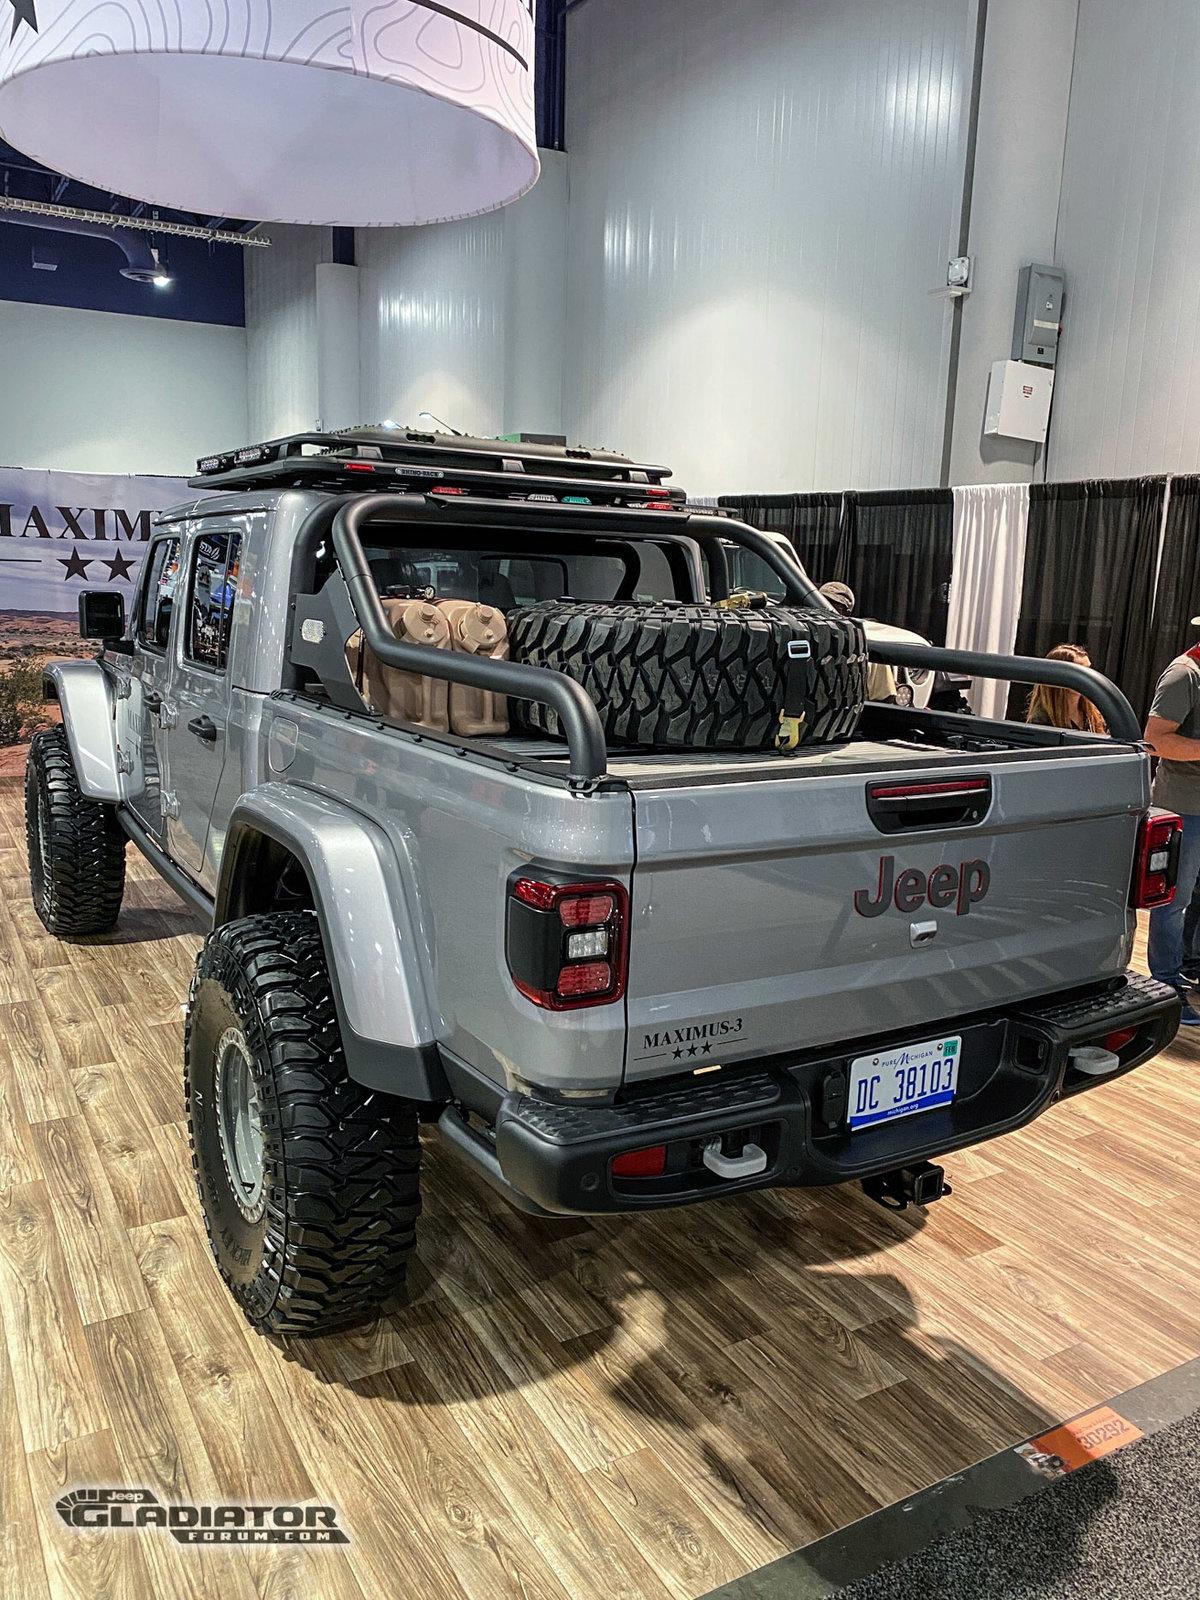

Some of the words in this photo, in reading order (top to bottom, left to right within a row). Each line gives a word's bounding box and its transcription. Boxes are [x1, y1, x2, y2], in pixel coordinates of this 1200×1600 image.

[0, 503, 163, 542] AXIM
[854, 855, 991, 918] Jeep
[643, 1018, 743, 1049] MAXIMUS-3
[881, 1059, 897, 1068] PURE
[856, 1075, 880, 1113] DC
[893, 1058, 954, 1103] 38103
[887, 1103, 919, 1116] michigan.org
[1078, 1418, 1130, 1449] 30292
